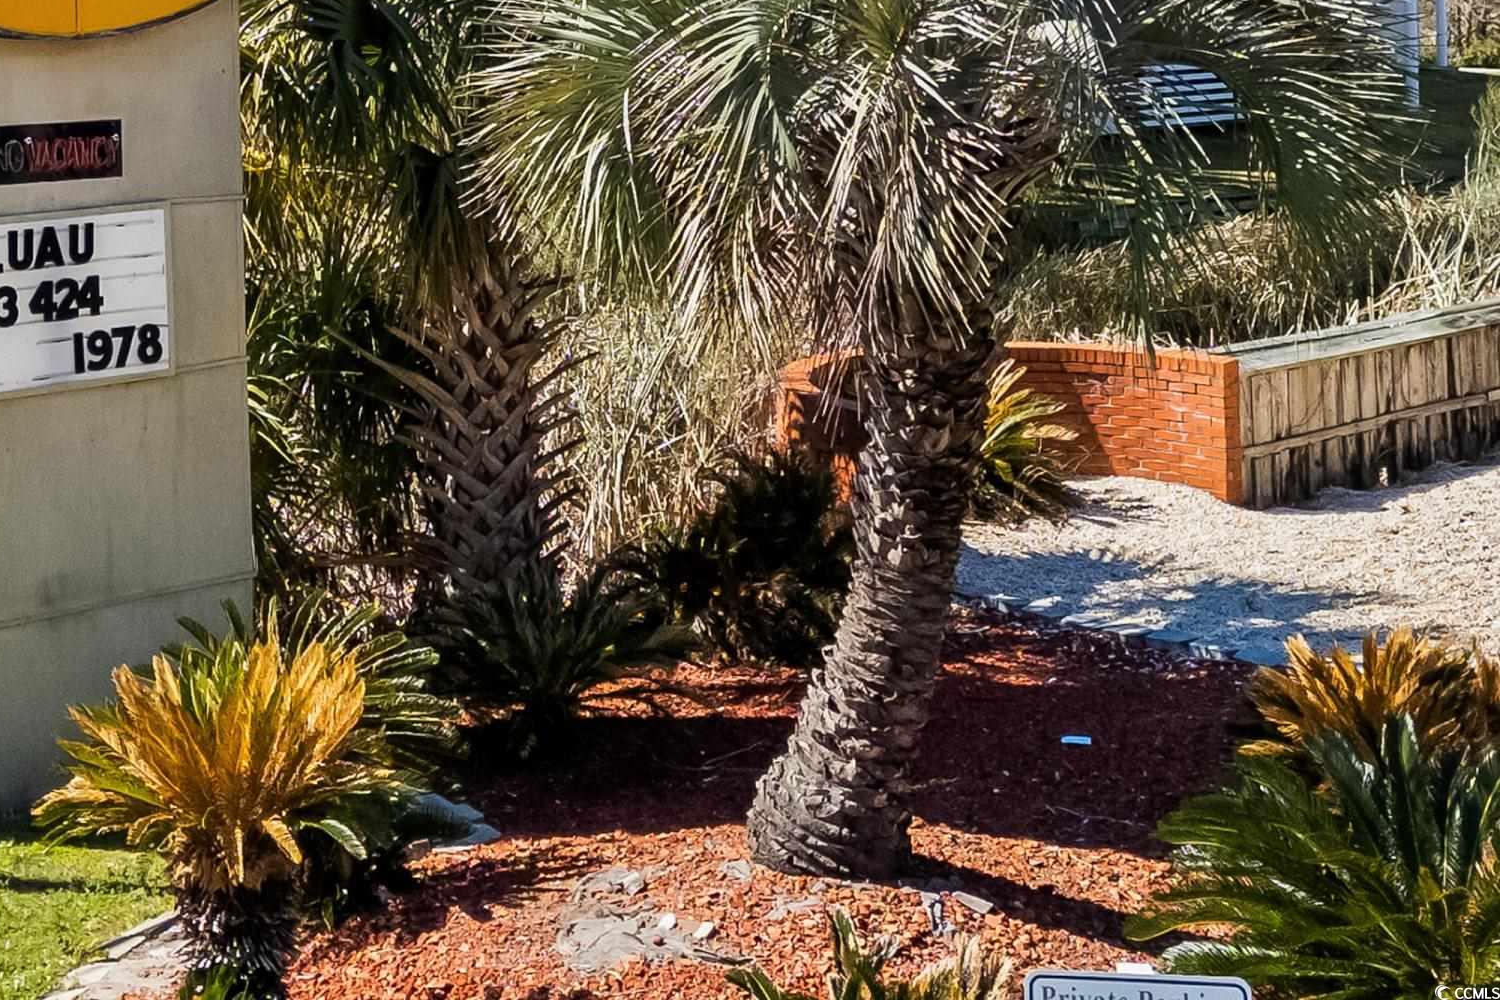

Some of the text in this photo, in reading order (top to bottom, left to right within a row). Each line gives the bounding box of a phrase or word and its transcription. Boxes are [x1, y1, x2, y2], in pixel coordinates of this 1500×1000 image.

[25, 134, 120, 173] VACANCY
[29, 275, 104, 322] 424
[73, 324, 163, 374] 1978
